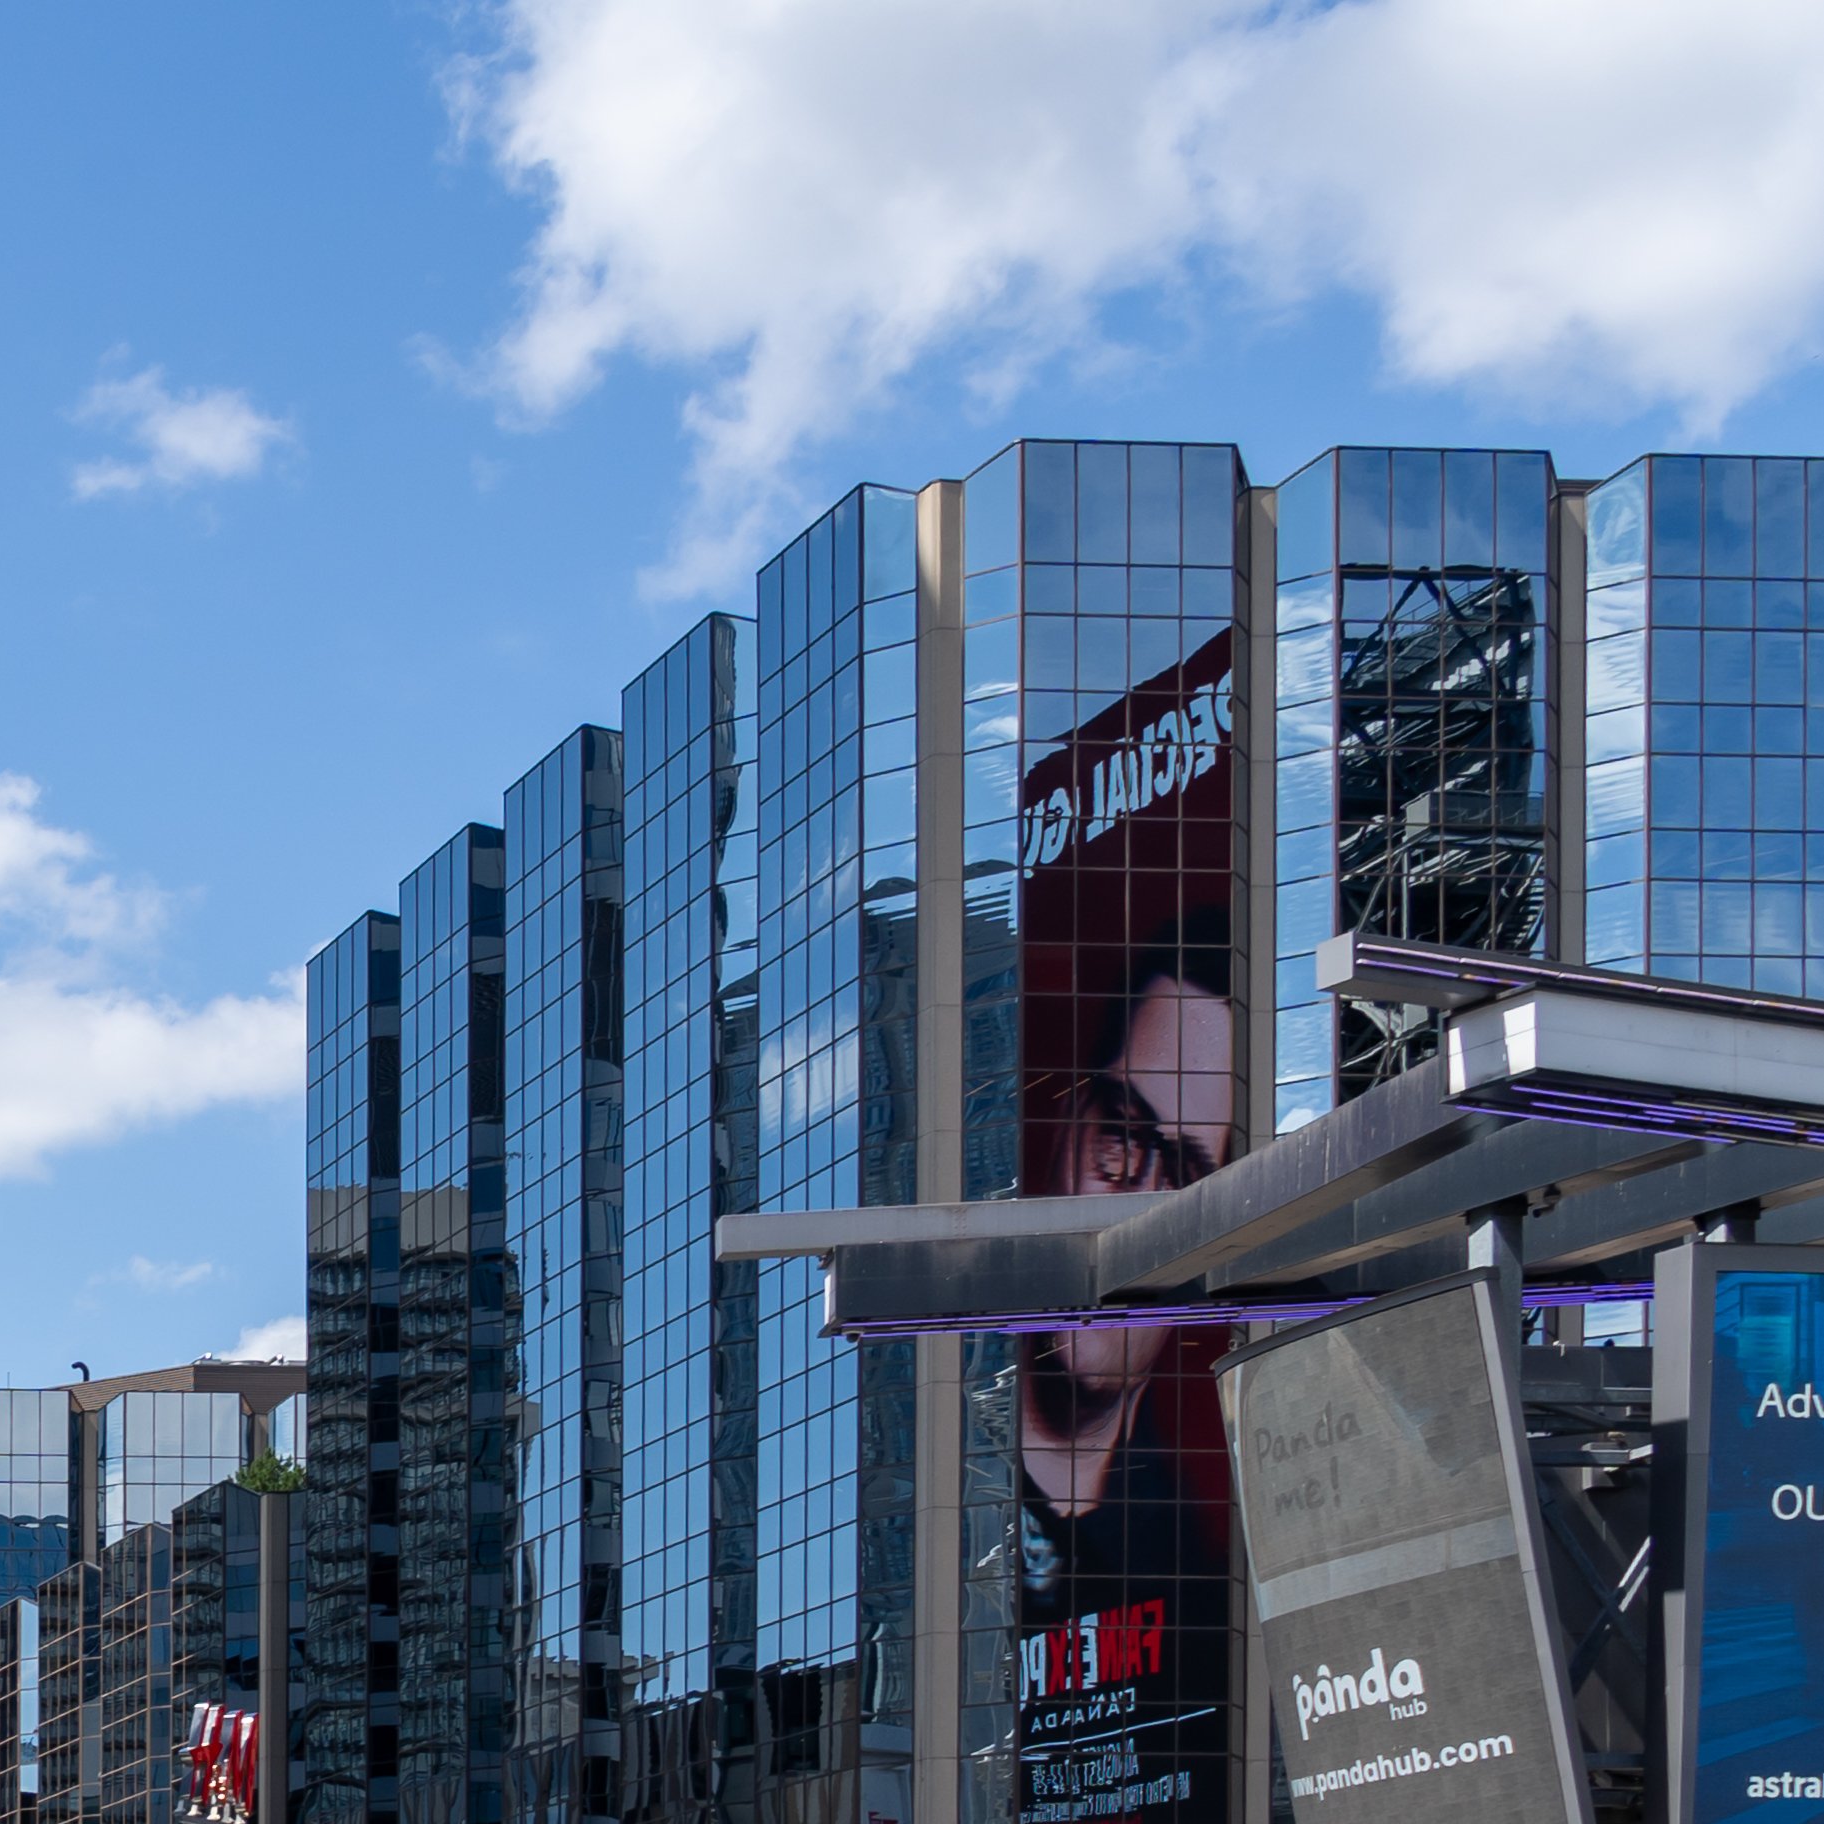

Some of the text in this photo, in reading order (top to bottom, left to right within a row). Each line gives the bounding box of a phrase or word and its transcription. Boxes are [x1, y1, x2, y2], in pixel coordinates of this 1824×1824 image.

[1254, 1400, 1362, 1473] Panda
[1275, 1455, 1341, 1516] me!
[1292, 1647, 1425, 1741] panda
[1389, 1698, 1428, 1721] hub
